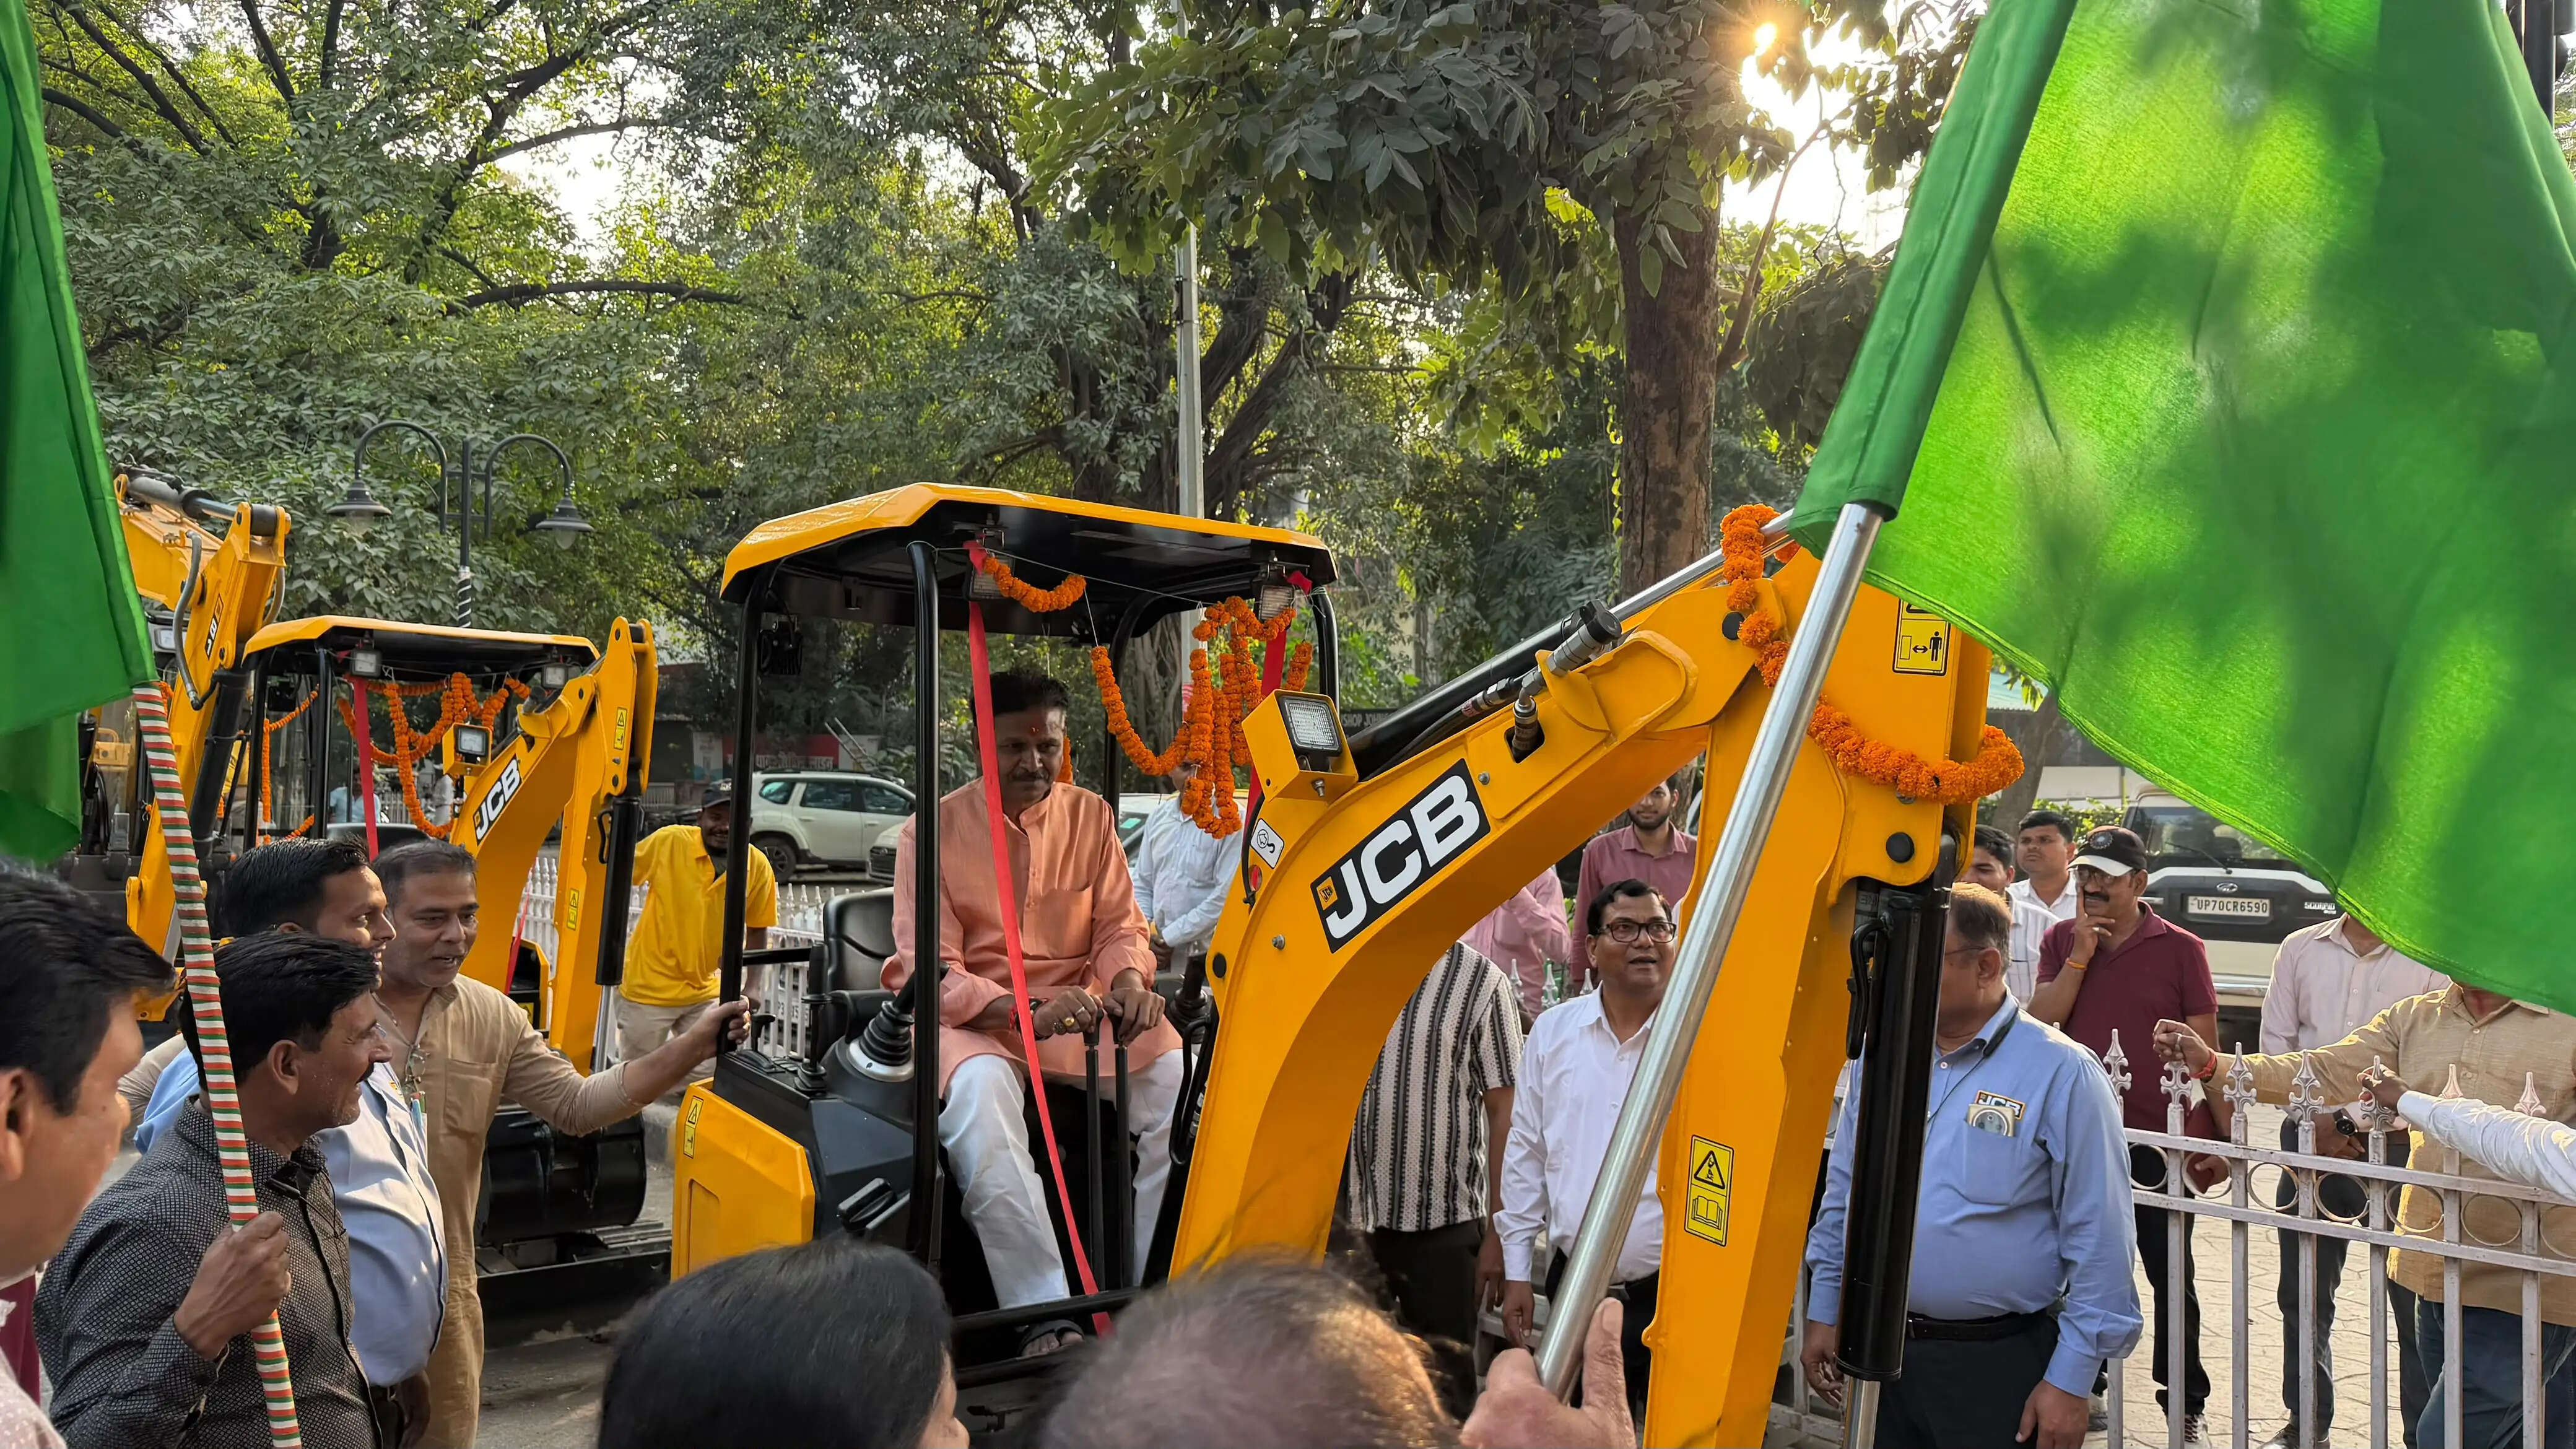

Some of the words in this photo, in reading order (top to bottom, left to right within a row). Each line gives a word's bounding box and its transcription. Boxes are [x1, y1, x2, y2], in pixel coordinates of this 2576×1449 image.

[476, 759, 520, 840] JCB
[1326, 775, 1480, 939] JCB
[2197, 899, 2268, 913] UP70CR6590
